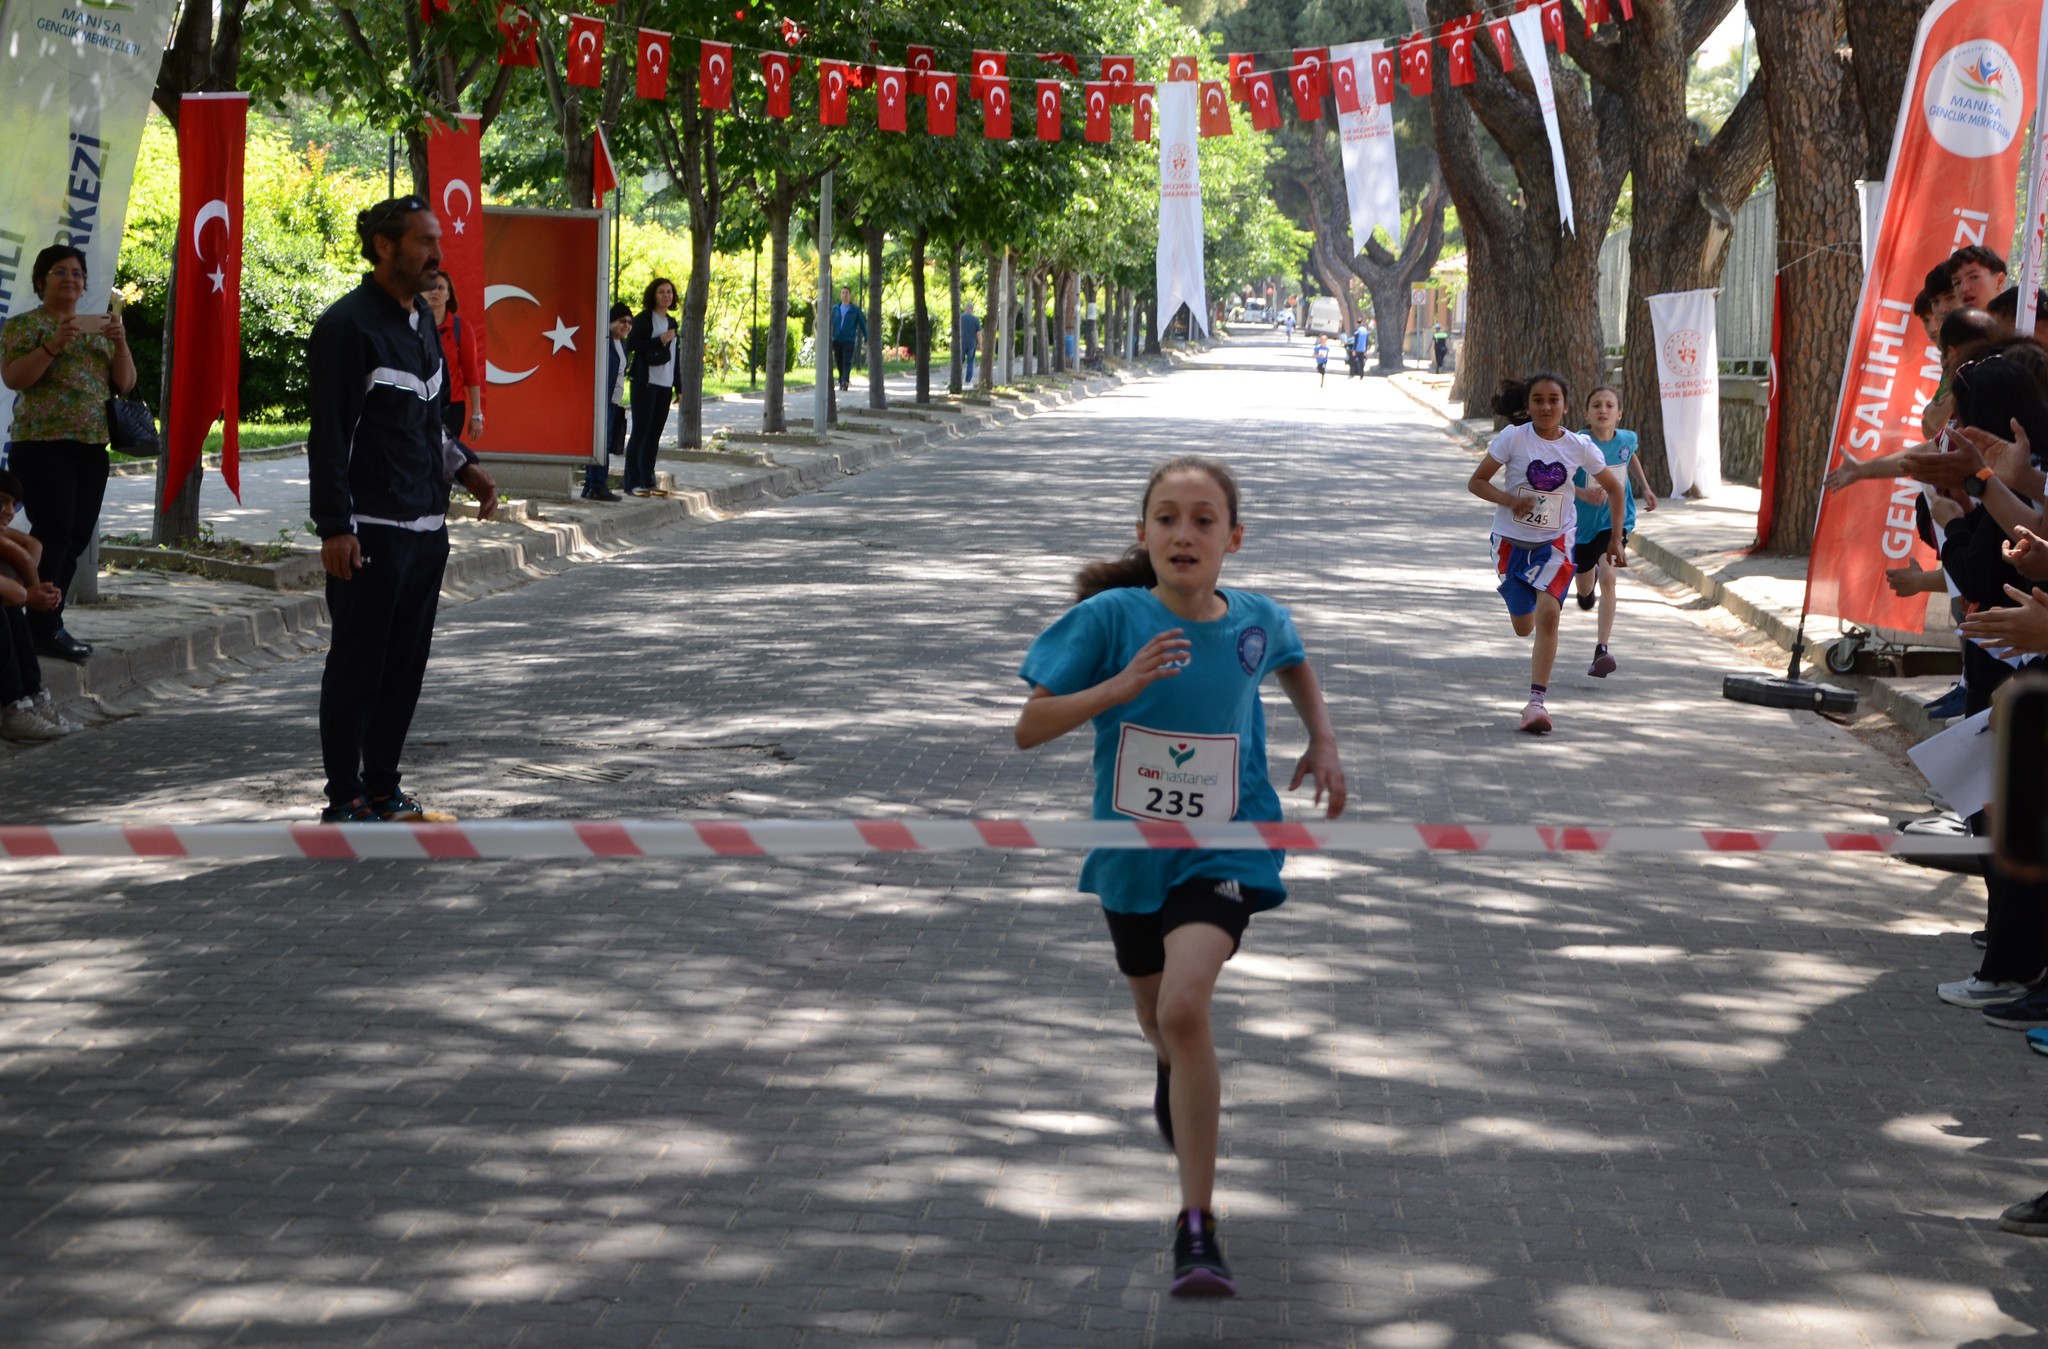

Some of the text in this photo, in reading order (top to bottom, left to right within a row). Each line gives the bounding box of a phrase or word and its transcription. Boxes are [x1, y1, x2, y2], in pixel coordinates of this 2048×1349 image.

[61, 8, 121, 34] MANİSA
[37, 18, 141, 56] GENÇLİK MERKEZLERİ
[53, 132, 111, 258] RKEZİ
[1850, 298, 1912, 452] SALİHLİ
[1526, 512, 1548, 525] 245
[1524, 564, 1541, 583] 4
[1145, 787, 1204, 818] 235
